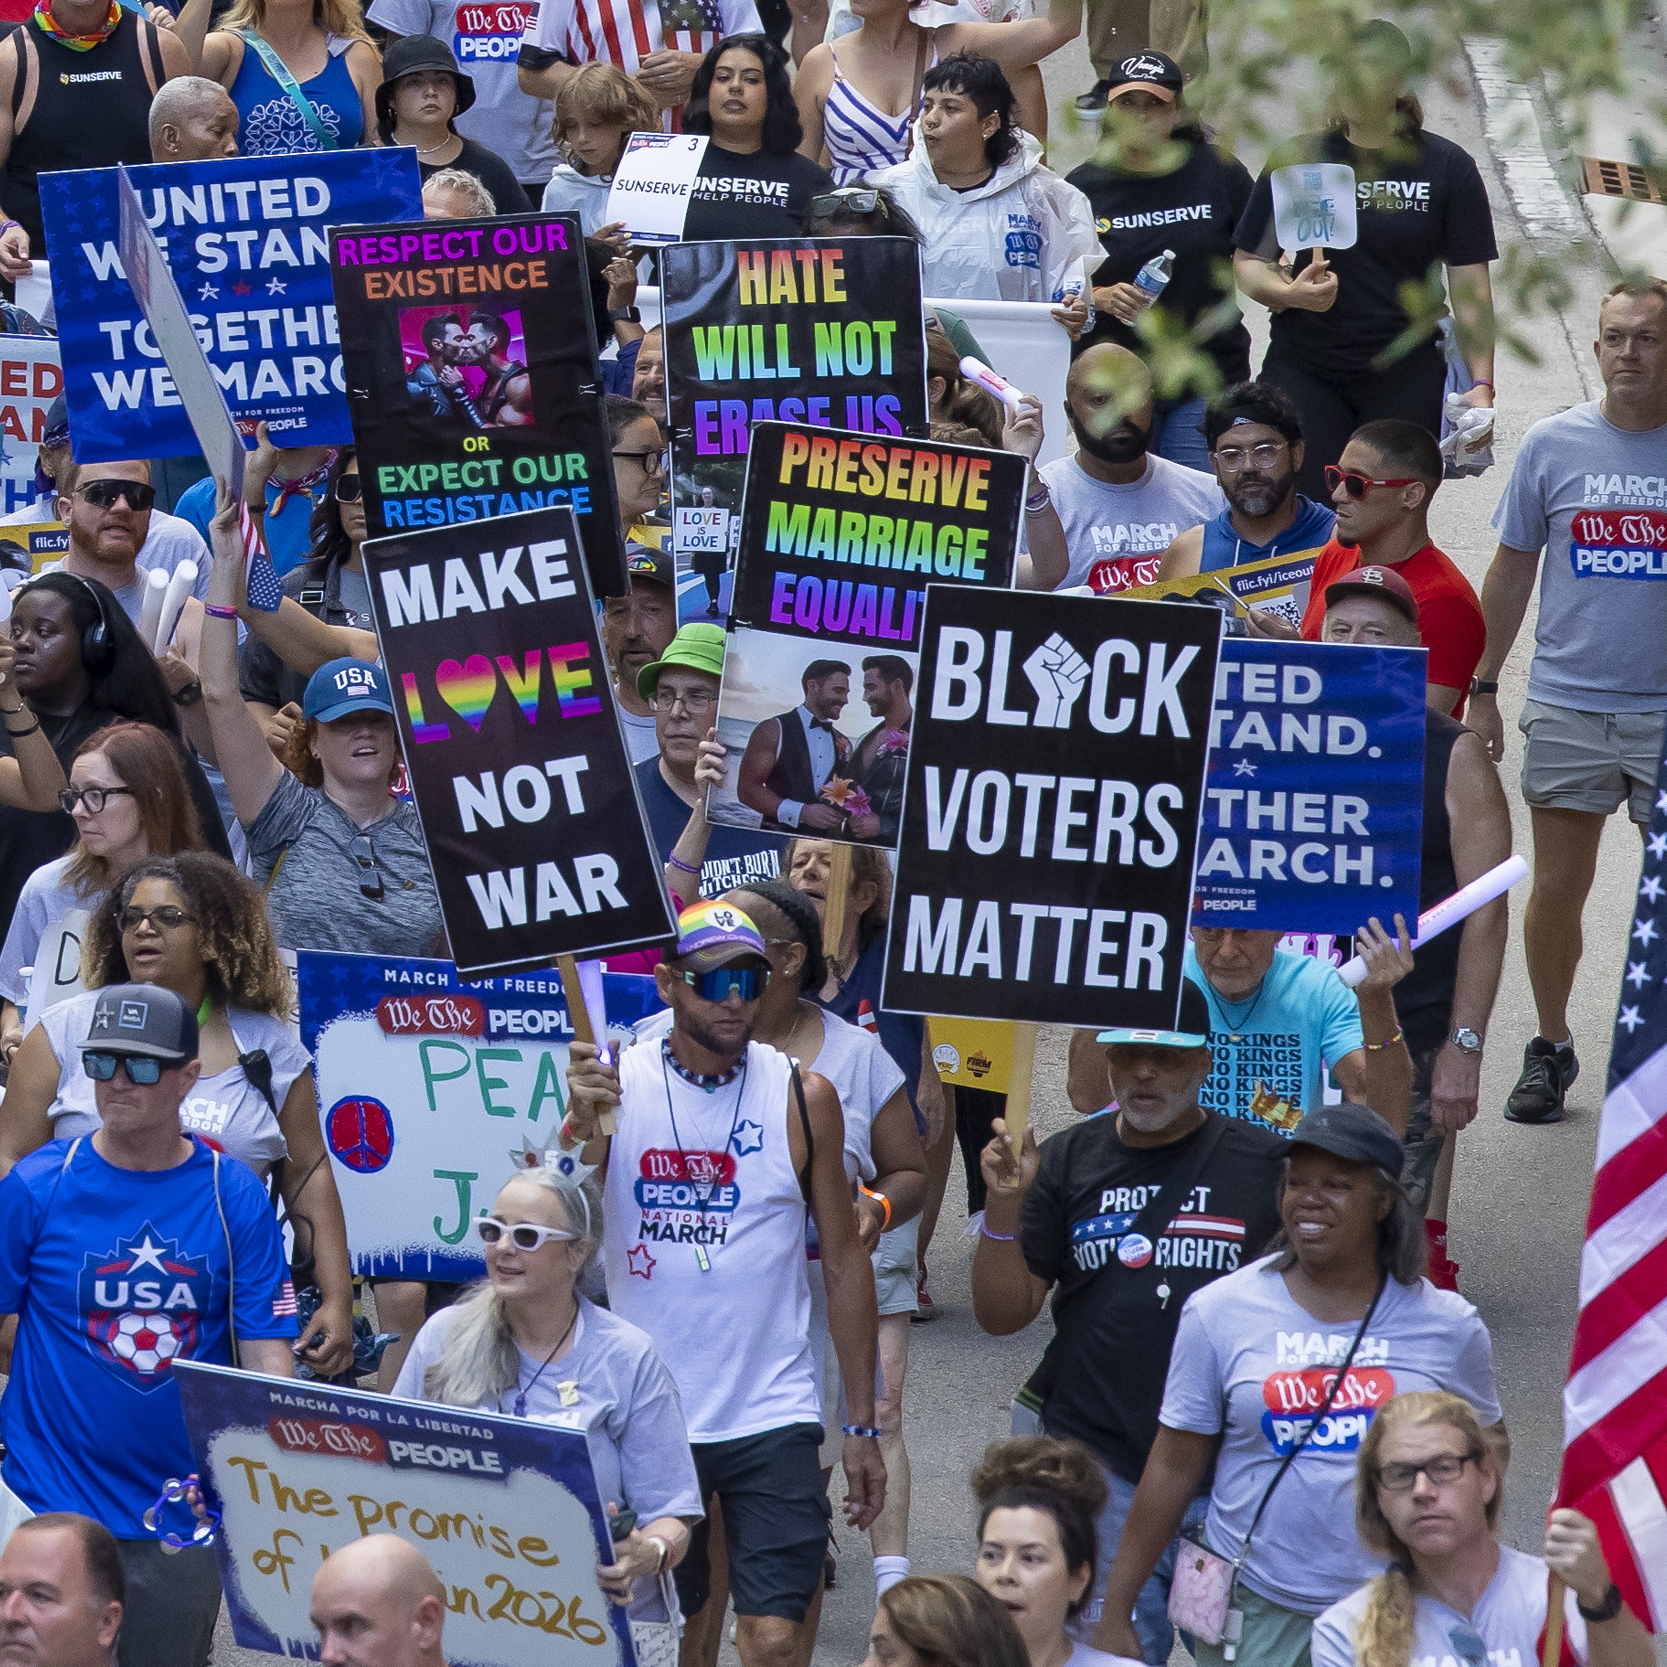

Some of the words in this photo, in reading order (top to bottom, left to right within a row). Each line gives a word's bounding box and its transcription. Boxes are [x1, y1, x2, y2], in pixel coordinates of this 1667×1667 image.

[69, 70, 123, 83] SUNSERVE
[338, 233, 485, 266] RESPECT
[492, 223, 568, 260] OUR
[365, 260, 548, 301] EXISTENCE
[737, 249, 847, 306] HATE
[692, 323, 807, 381] WILL
[813, 320, 896, 376] NOT
[378, 460, 506, 496] EXPECT
[512, 451, 589, 487] OUR
[463, 435, 491, 453] OR
[778, 432, 992, 512] PRESERVE
[683, 512, 721, 525] LOVE
[683, 535, 718, 547] LOVE
[765, 501, 989, 581] MARRIAGE
[381, 538, 576, 629] MAKE
[453, 754, 591, 834] NOT
[924, 766, 1184, 869] VOTERS
[466, 853, 629, 931] WAR
[903, 893, 1169, 992] MATTER
[94, 1279, 199, 1311] USA
[226, 1455, 340, 1517] The
[348, 1491, 562, 1568] promise
